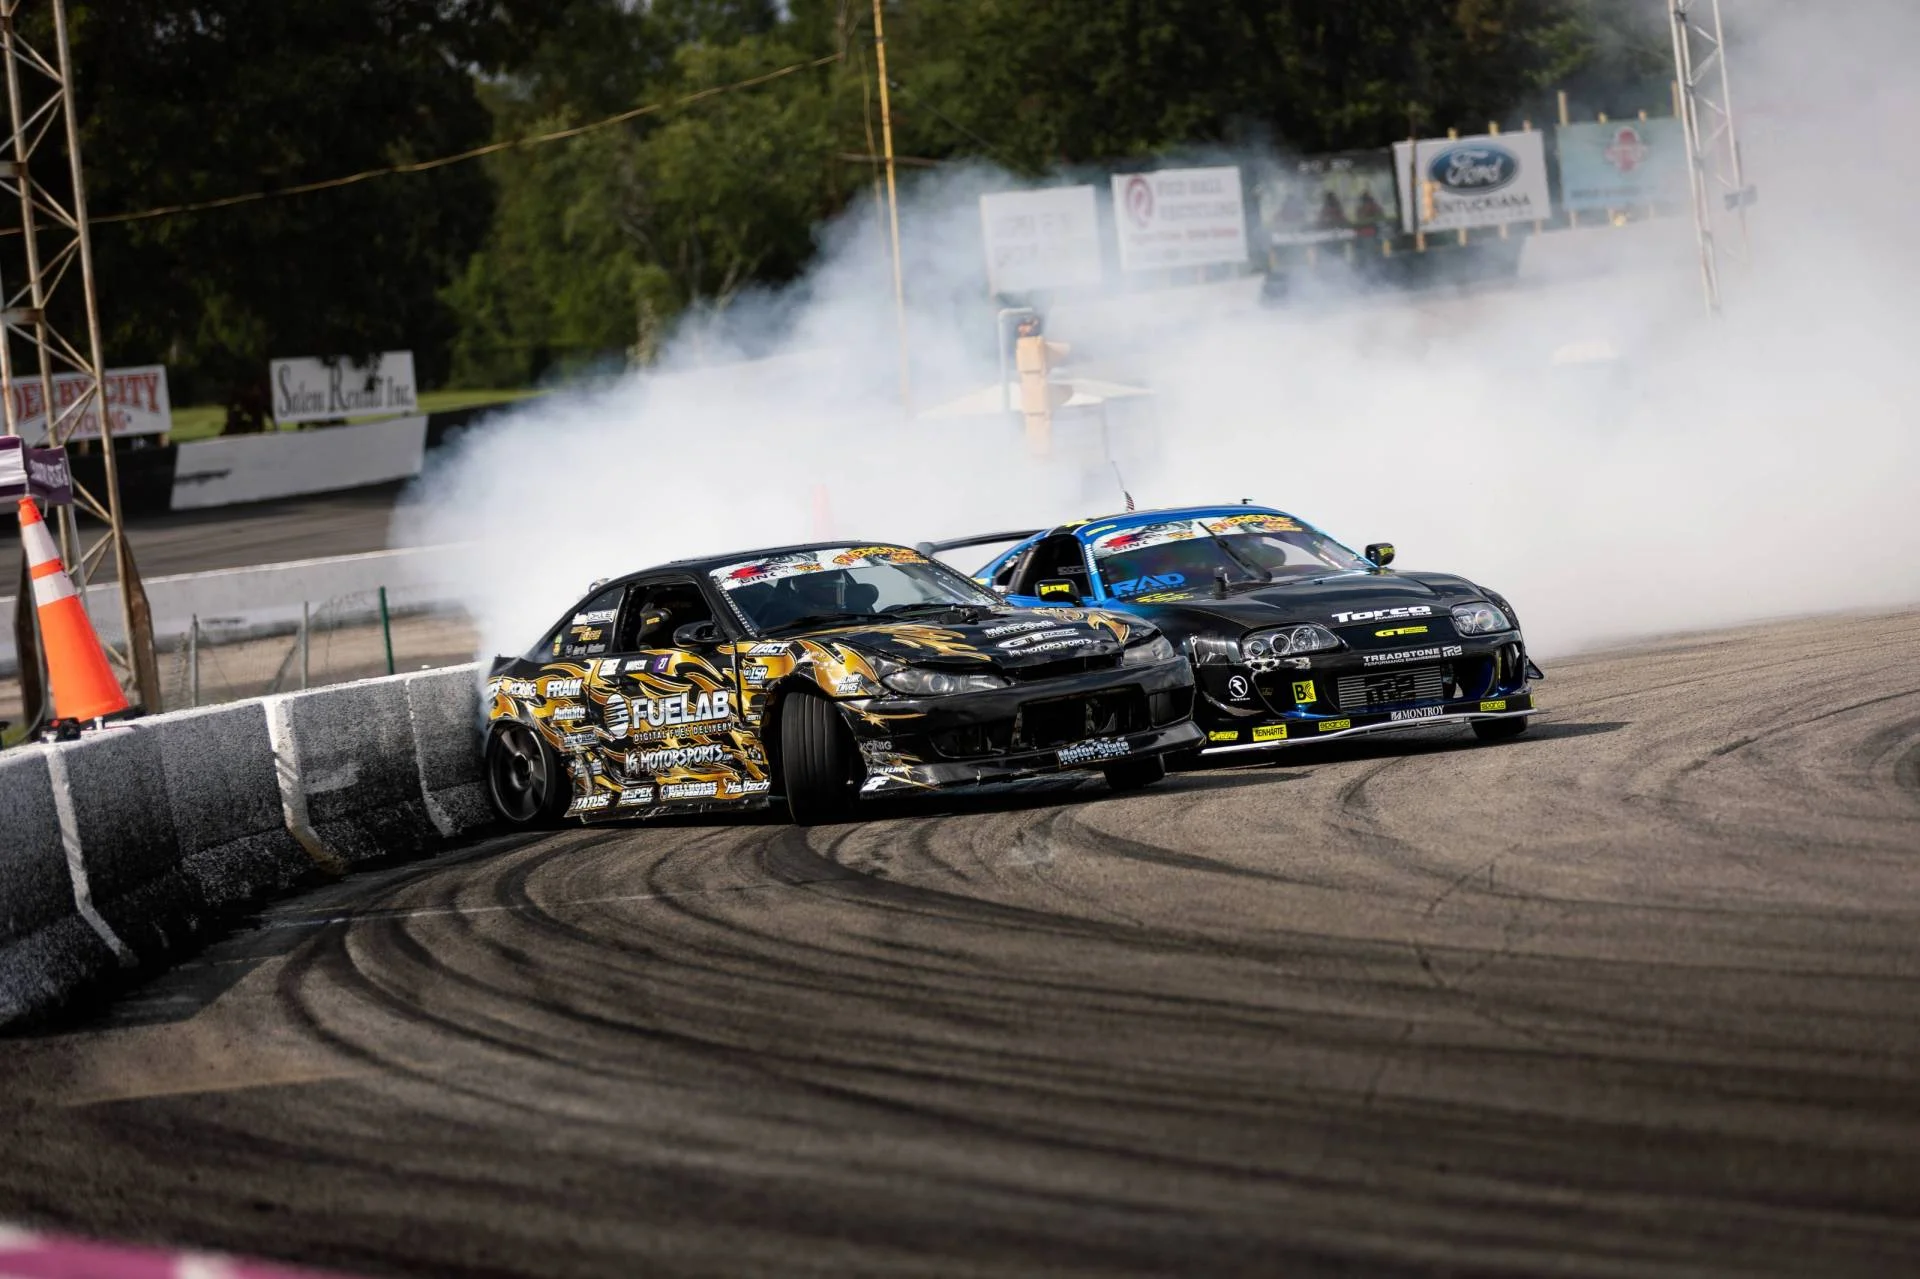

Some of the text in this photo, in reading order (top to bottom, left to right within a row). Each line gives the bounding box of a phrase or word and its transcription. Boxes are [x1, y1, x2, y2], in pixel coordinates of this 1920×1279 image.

[1446, 149, 1504, 186] Ford
[1432, 194, 1531, 214] ENTUCKIANA
[1111, 573, 1185, 596] RAD
[1331, 605, 1431, 623] Torco
[1363, 648, 1440, 662] TREADSTONE
[1364, 658, 1405, 667] PERFORMANCE
[546, 678, 583, 698] FRAM
[631, 689, 730, 729] FUELAB
[1402, 705, 1444, 719] MONTROY
[634, 722, 732, 743] DIGITAL FUEL DELIVERY
[724, 778, 771, 794] Haltech
